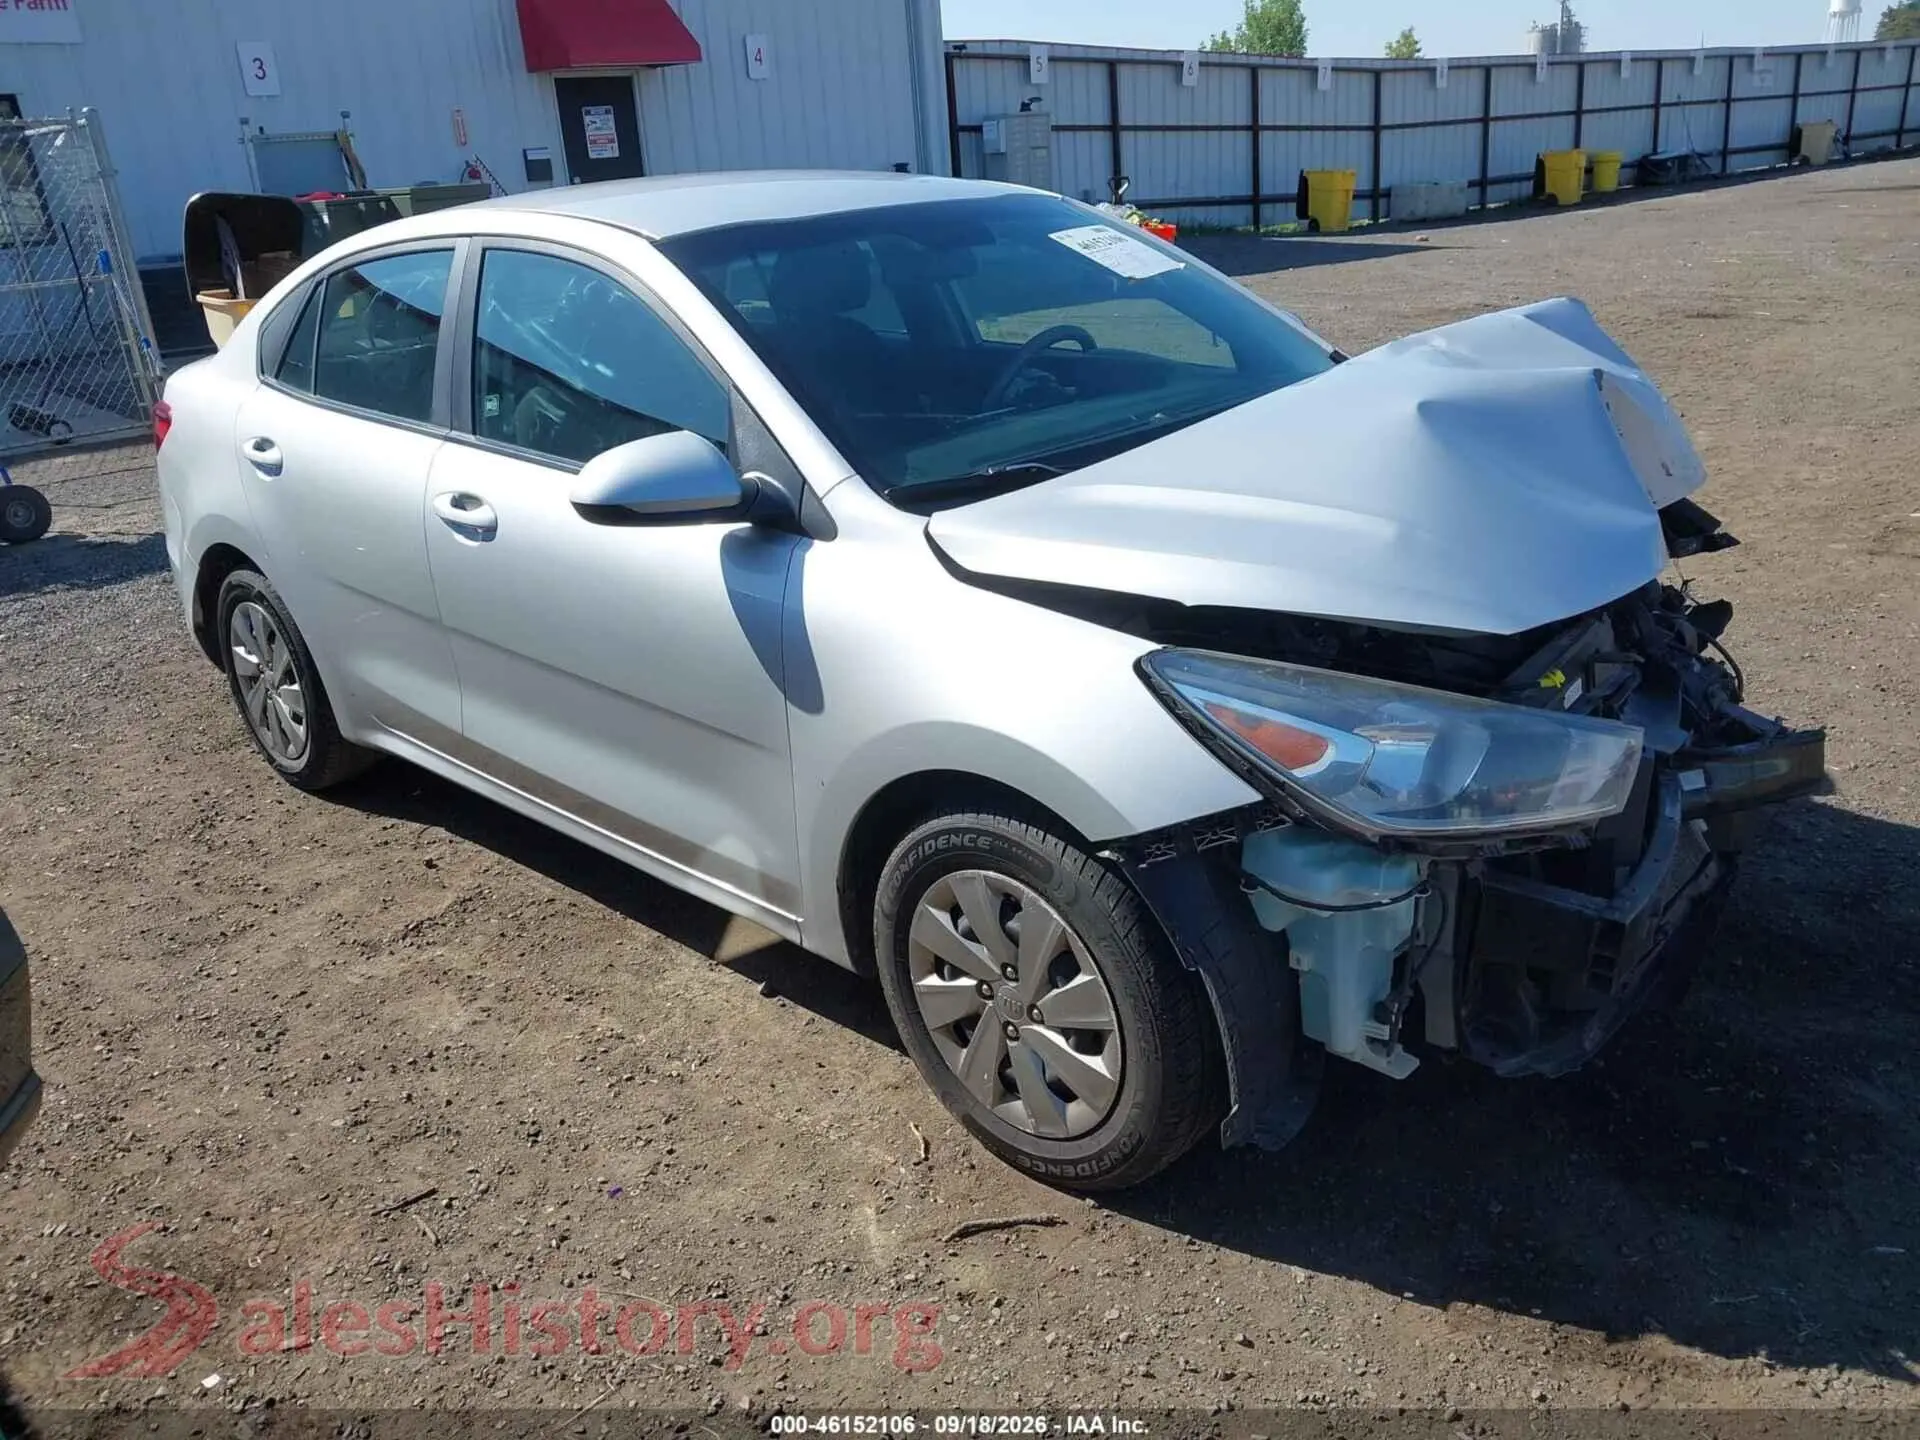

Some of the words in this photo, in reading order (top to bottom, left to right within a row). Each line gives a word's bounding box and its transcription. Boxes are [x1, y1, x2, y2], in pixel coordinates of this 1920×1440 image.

[754, 47, 763, 67] 4
[1035, 55, 1043, 73] 5
[252, 57, 266, 80] 3
[889, 833, 993, 894] CONFIDENCE
